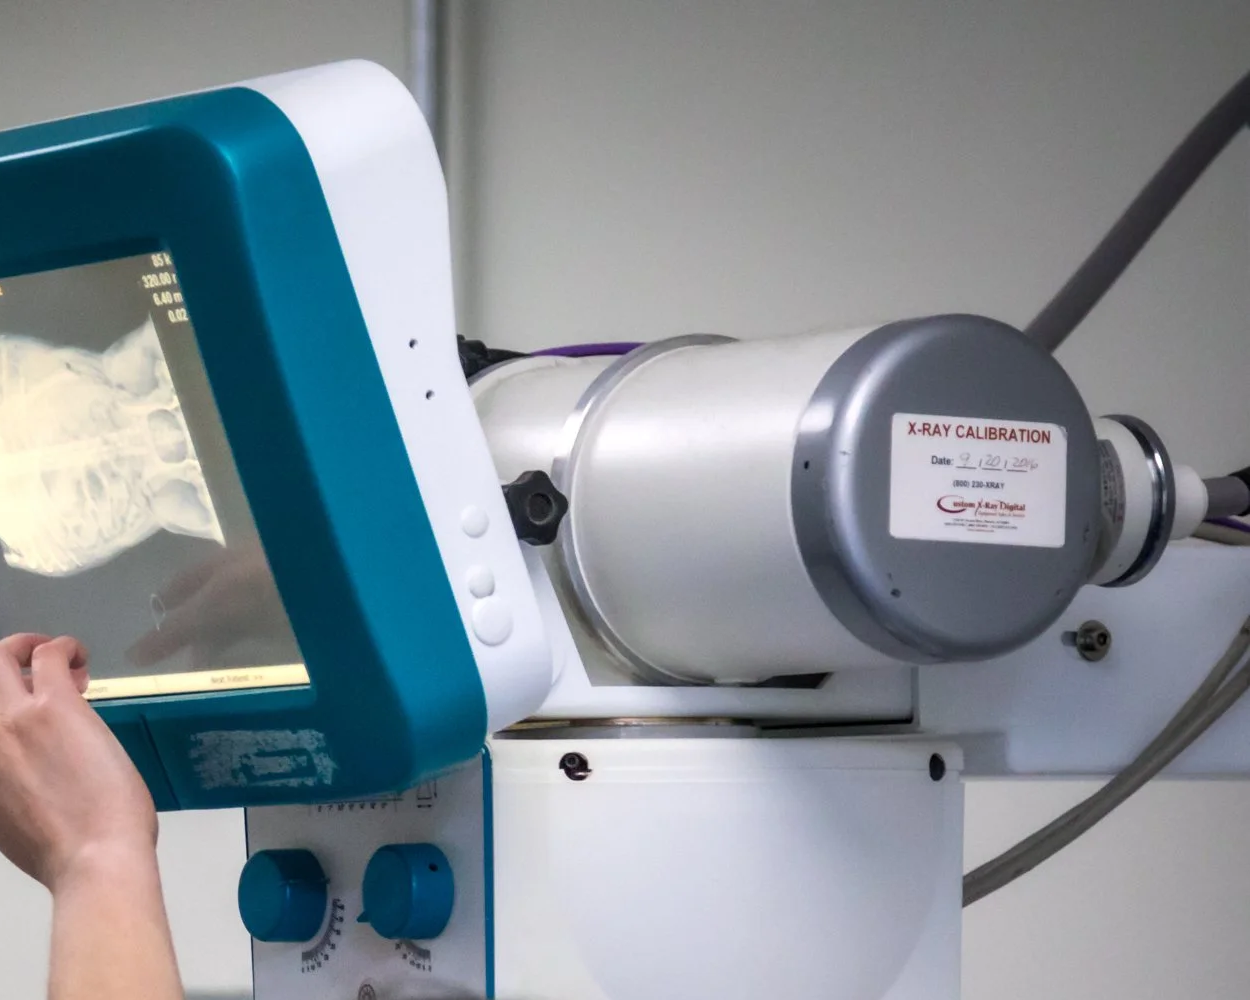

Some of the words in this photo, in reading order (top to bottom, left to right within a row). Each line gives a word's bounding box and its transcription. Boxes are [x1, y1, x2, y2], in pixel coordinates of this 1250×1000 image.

[167, 307, 189, 323] 0.02
[908, 421, 952, 437] X-RAY
[955, 425, 1051, 444] CALIBRATION
[931, 455, 954, 466] Date:
[995, 499, 1026, 512] Digital
